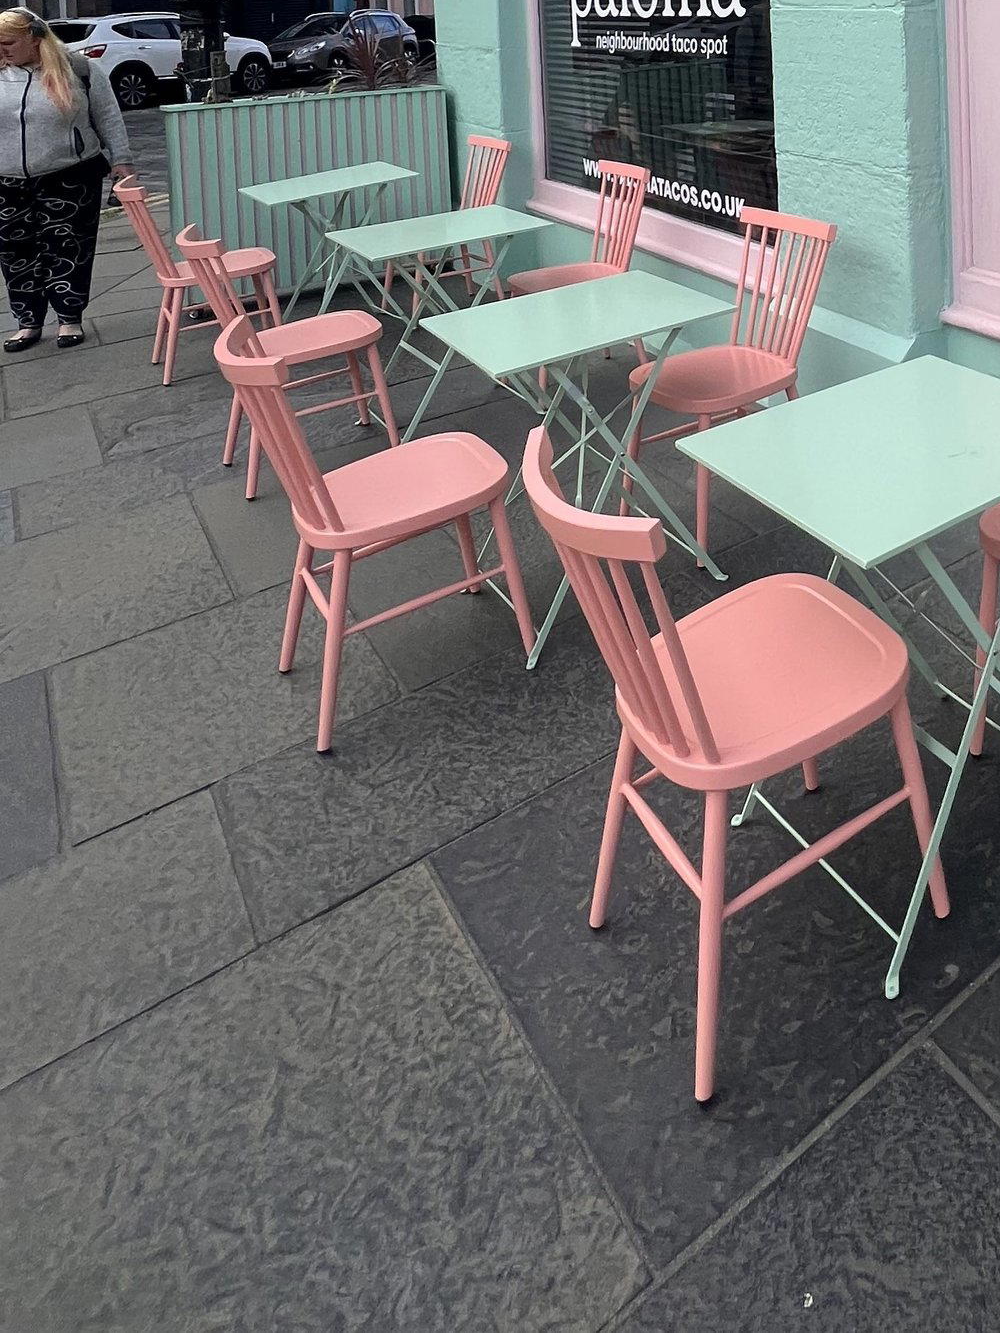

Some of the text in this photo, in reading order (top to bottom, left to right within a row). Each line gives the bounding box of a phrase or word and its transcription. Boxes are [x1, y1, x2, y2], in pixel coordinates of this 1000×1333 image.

[595, 31, 728, 59] neighbourhood taco spot
